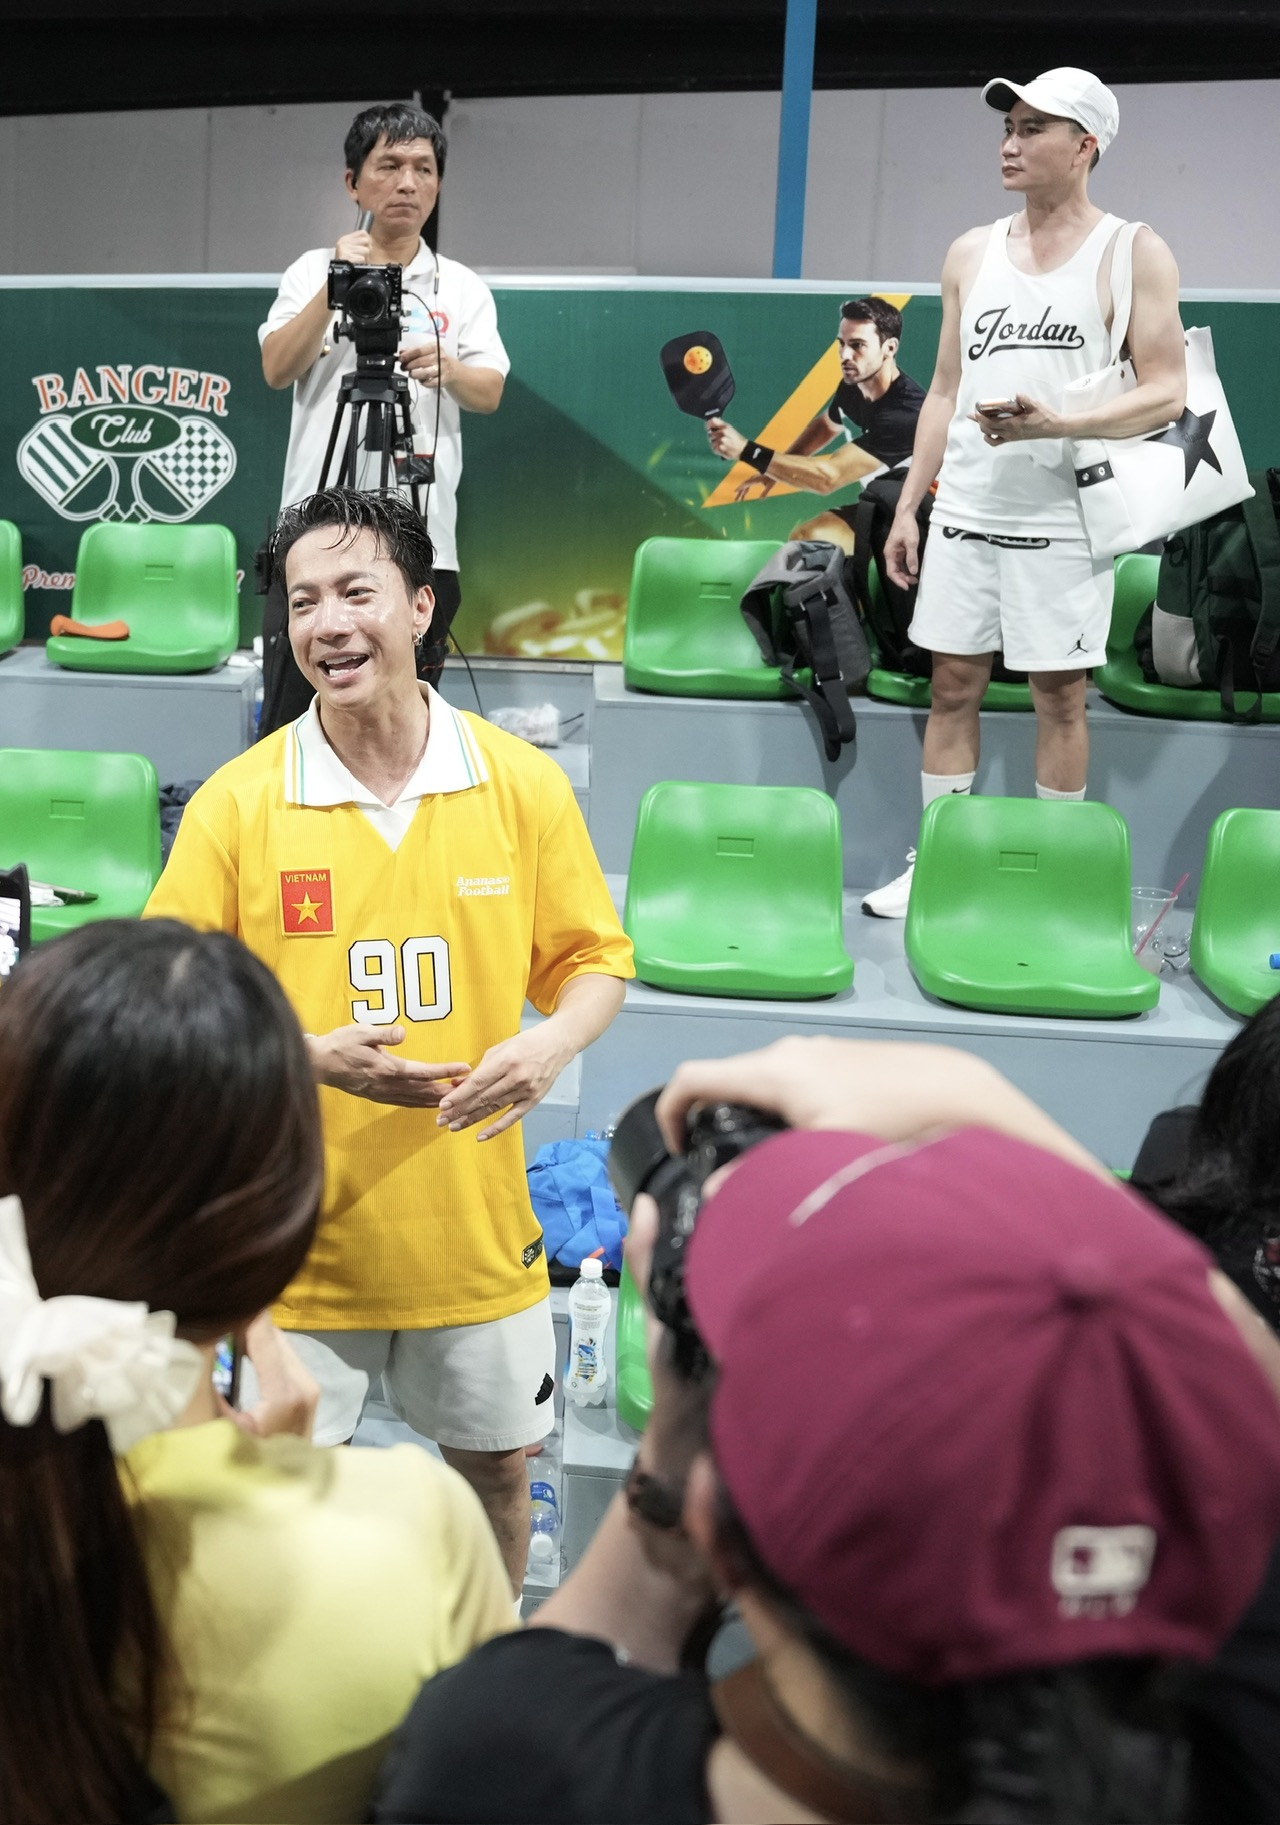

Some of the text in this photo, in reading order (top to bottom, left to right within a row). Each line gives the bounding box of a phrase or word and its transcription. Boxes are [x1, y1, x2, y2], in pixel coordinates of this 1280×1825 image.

[968, 304, 1085, 361] Jordan
[32, 364, 231, 417] BANGER
[90, 413, 155, 448] Club
[284, 872, 328, 884] VIETNAM
[457, 885, 510, 897] Football
[348, 935, 452, 1026] 90
